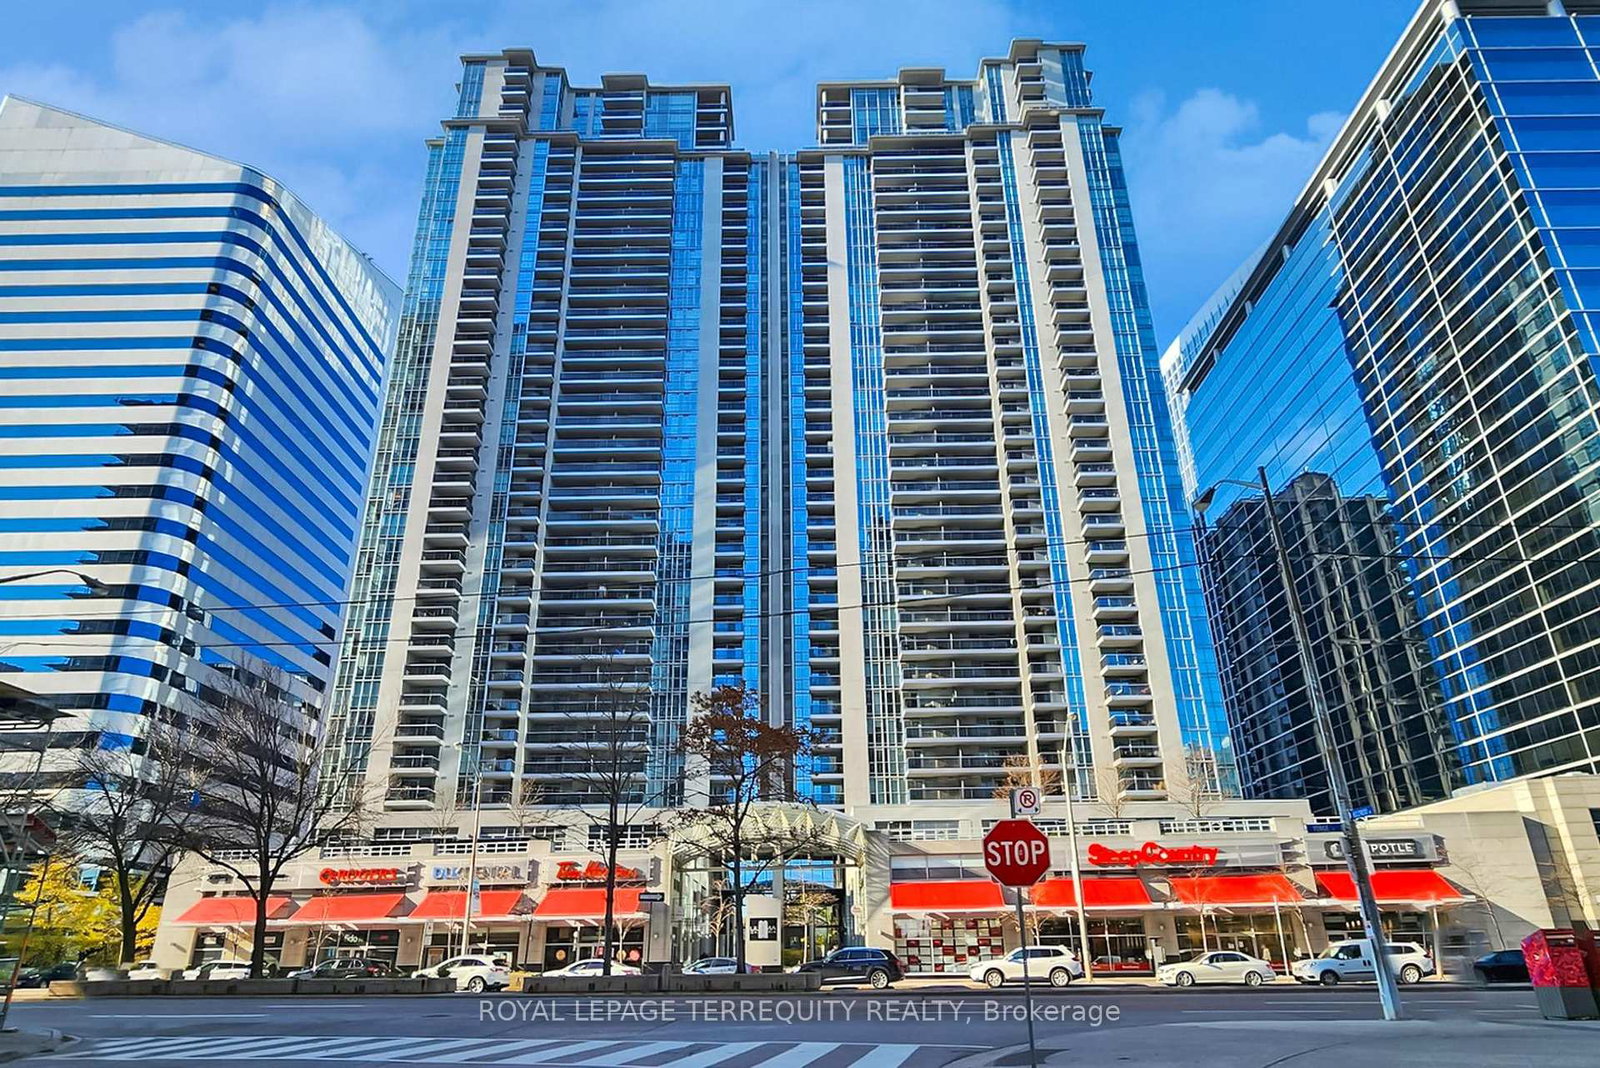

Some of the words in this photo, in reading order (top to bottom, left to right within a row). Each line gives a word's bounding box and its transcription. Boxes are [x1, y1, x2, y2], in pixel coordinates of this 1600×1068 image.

[987, 839, 1046, 867] STOP
[1141, 841, 1218, 866] Country
[1330, 842, 1415, 857] CPOTLE
[339, 868, 398, 882] ROGERS
